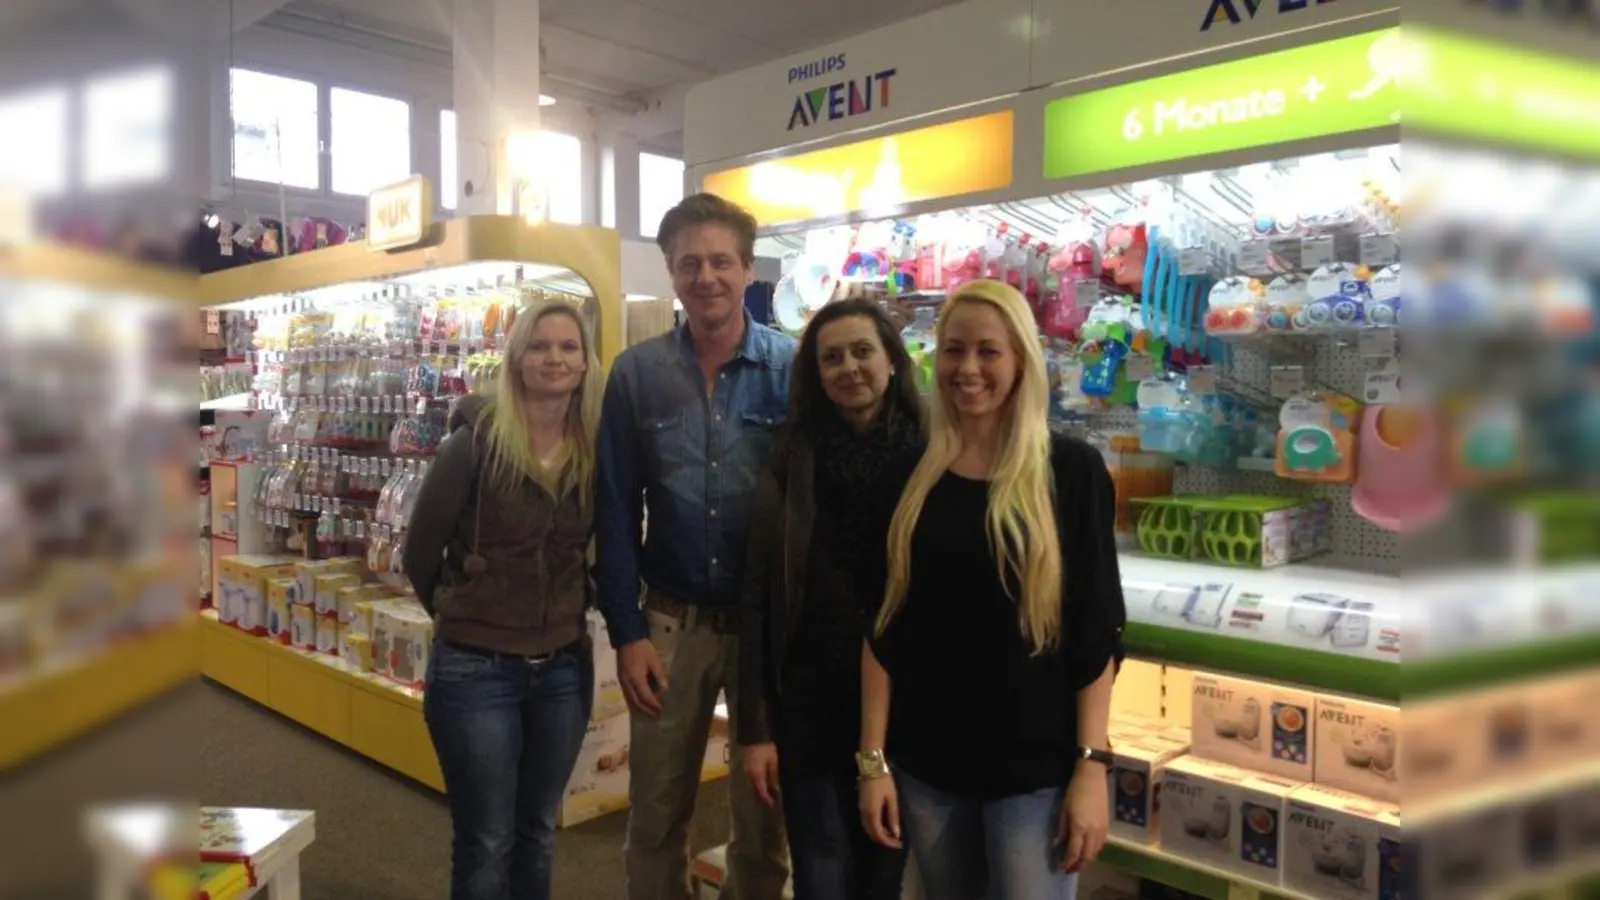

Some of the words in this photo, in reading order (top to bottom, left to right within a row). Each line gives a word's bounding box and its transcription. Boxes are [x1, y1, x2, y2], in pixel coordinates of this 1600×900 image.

[788, 53, 846, 84] PHILIPS
[787, 68, 897, 131] AVENT
[1122, 108, 1143, 141] 6
[1153, 89, 1286, 136] Monate
